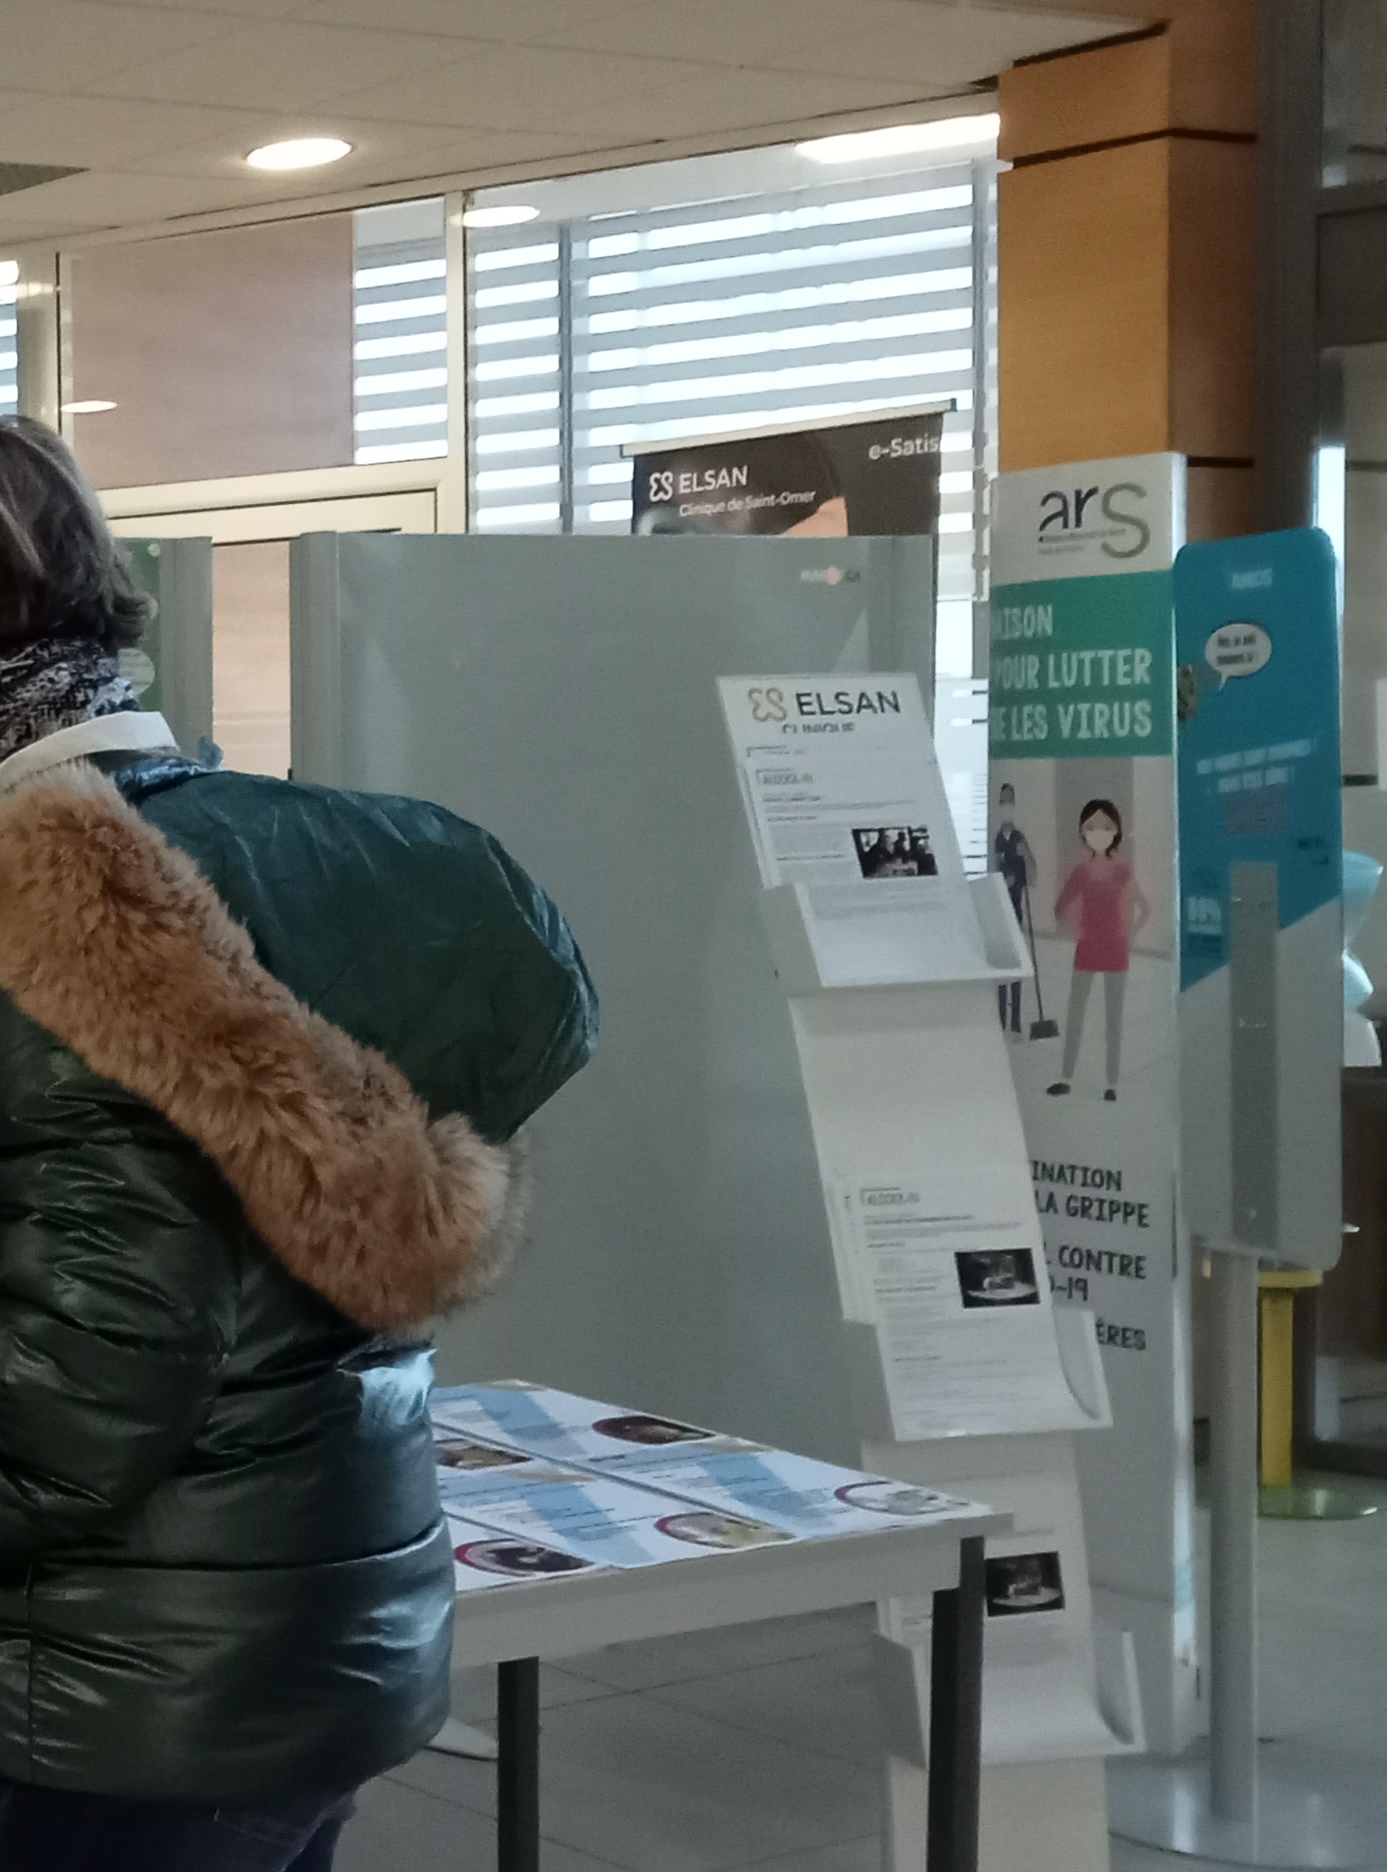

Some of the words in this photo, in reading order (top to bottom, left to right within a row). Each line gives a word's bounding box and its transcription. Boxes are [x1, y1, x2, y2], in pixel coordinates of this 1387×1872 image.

[679, 465, 748, 494] ELSAN
[679, 501, 726, 517] Clinique
[727, 497, 744, 512] de
[745, 489, 817, 511] Saint-Omer
[1048, 648, 1153, 688] LUTTER
[795, 690, 902, 716] ELSAN
[1011, 704, 1049, 741] LES
[1057, 699, 1153, 739] VIRUS
[1066, 1194, 1150, 1229] GRIPPE
[1058, 1245, 1148, 1280] CONTRE
